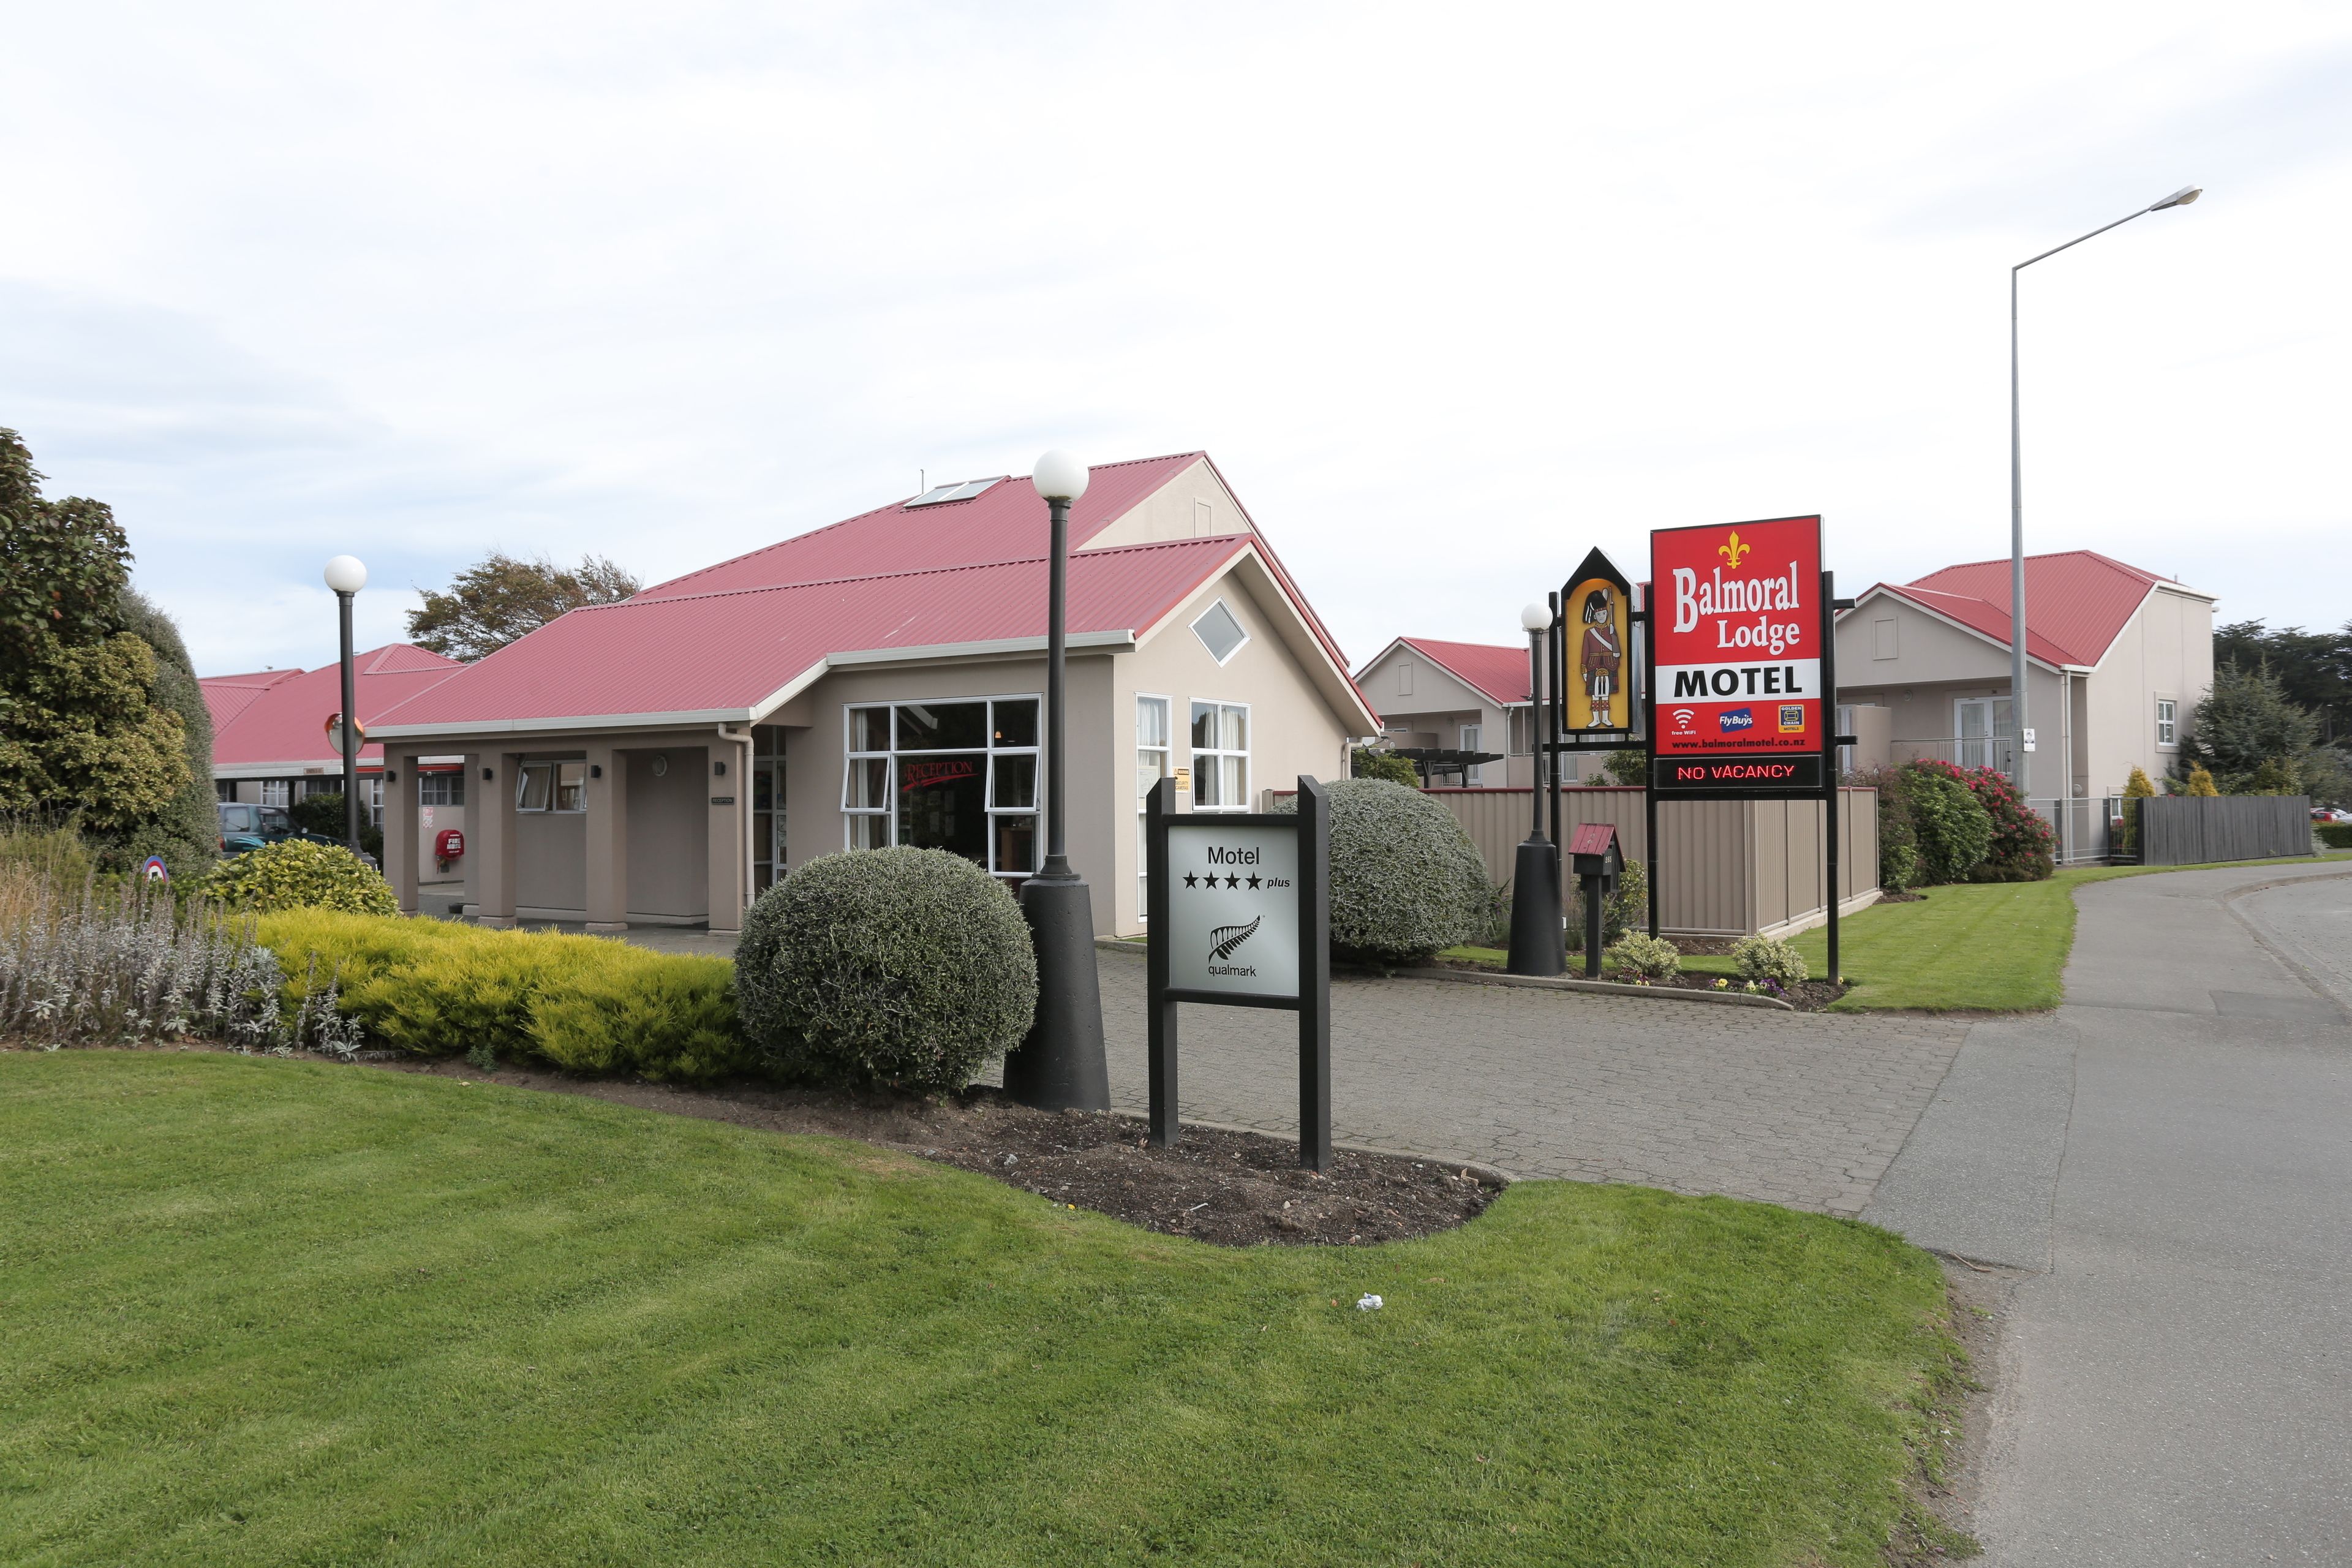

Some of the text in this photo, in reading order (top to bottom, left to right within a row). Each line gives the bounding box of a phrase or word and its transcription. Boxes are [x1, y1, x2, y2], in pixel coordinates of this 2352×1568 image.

[1673, 560, 1800, 633] Balmoral
[1717, 615, 1800, 655] Lodge
[1674, 666, 1802, 697] MOTEL
[1672, 737, 1806, 748] www.balmoralmotel.co.nz
[905, 761, 973, 783] RECEPTION
[1678, 764, 1795, 780] NO VACANCY
[1208, 846, 1259, 865] Motel
[1267, 877, 1290, 889] plus
[1208, 964, 1256, 977] qualmark
